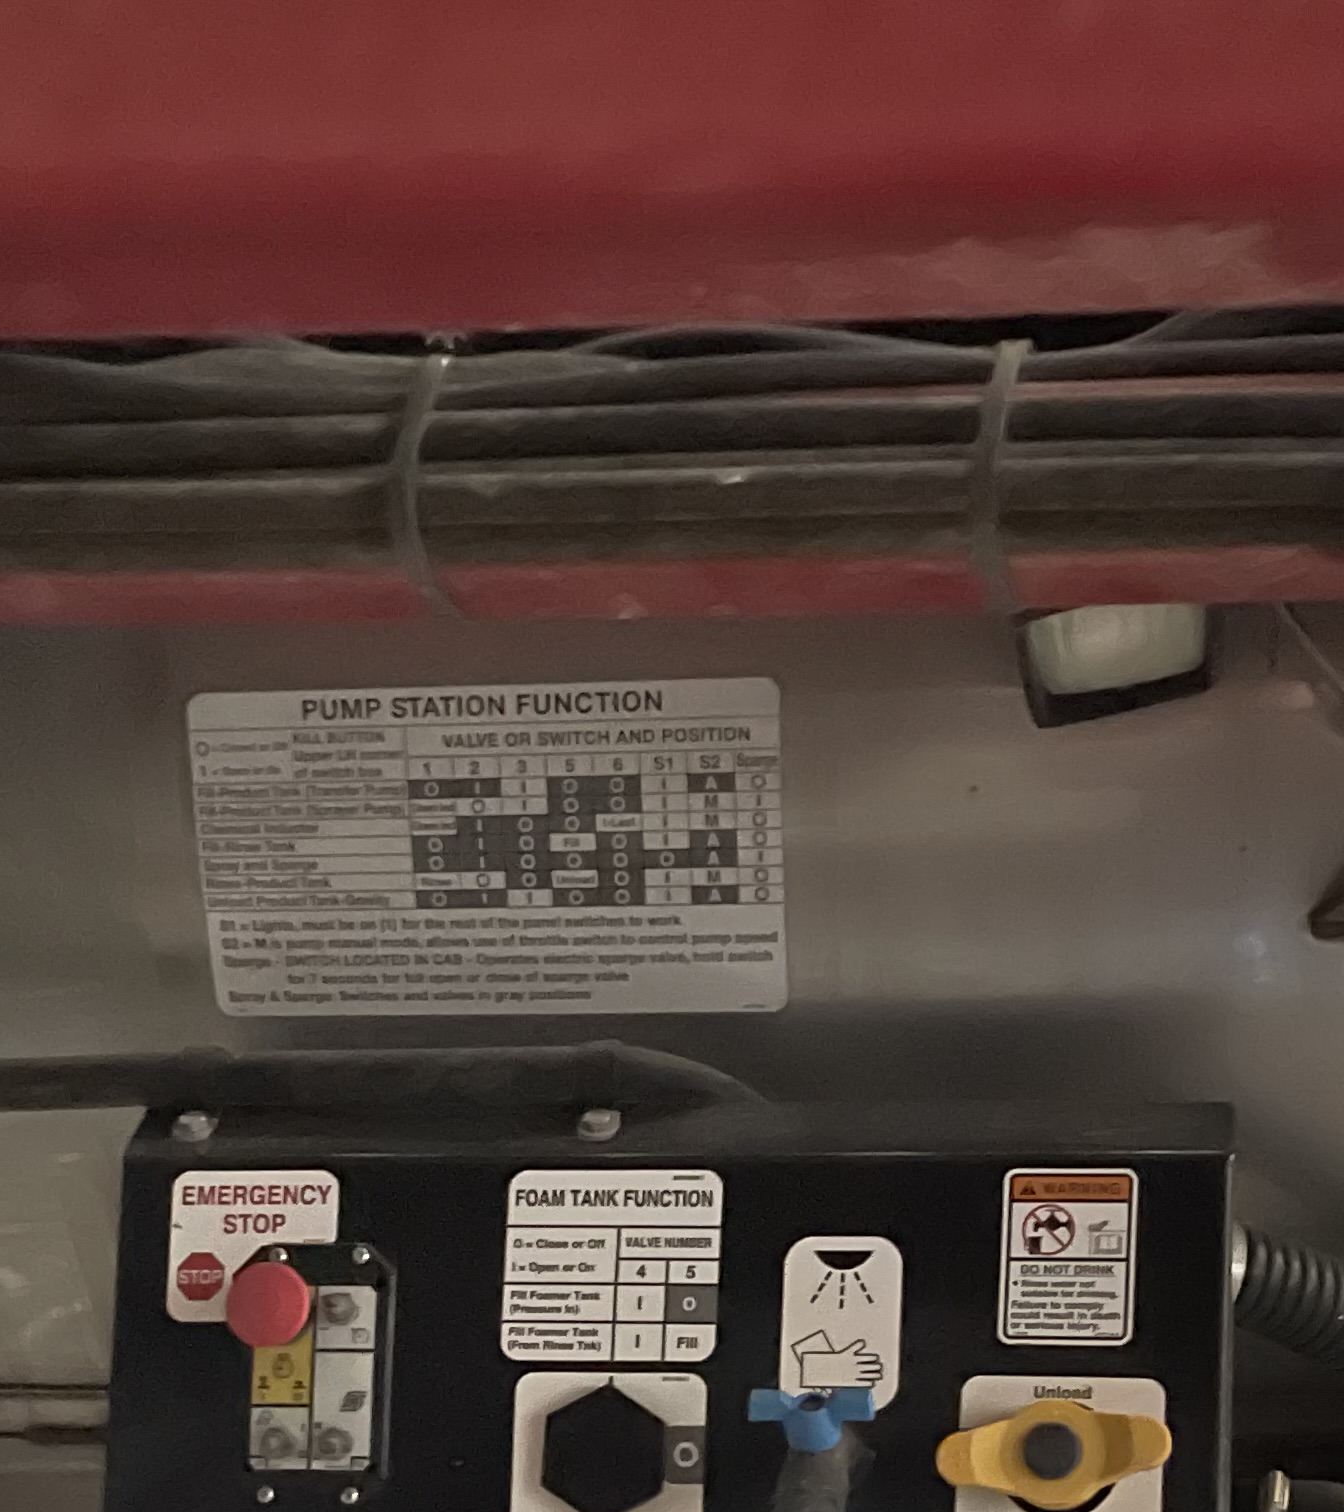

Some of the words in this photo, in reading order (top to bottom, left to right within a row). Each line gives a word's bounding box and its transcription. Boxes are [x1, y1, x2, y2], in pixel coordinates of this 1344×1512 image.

[302, 698, 382, 721] PUMP
[391, 694, 504, 719] STATION
[516, 690, 663, 715] FUNCTION
[442, 732, 498, 748] VALVE
[506, 731, 531, 746] OR
[537, 730, 611, 746] SWITCH
[616, 729, 655, 744] AND
[662, 726, 751, 743] POSITION
[422, 762, 432, 776] 1
[470, 761, 480, 775] 2
[565, 759, 575, 773] 5
[613, 758, 623, 771] 6
[654, 756, 673, 771] S1
[700, 755, 721, 769] S2
[181, 1184, 332, 1206] EMERGENCY
[1042, 1182, 1121, 1196] WARNING
[514, 1189, 566, 1208] FOAM
[570, 1189, 619, 1207] TANK
[623, 1189, 714, 1208] FUNCTION
[223, 1213, 287, 1234] STOP
[625, 1237, 662, 1248] VALVE
[664, 1237, 712, 1249] NUMBER
[178, 1269, 224, 1284] STOP
[636, 1265, 647, 1278] 4
[685, 1265, 697, 1279] 5
[1020, 1264, 1039, 1275] DO
[1043, 1264, 1070, 1275] NOT
[1074, 1264, 1115, 1275] DRINK
[676, 1337, 698, 1349] Fill
[1033, 1385, 1093, 1400] Unload
